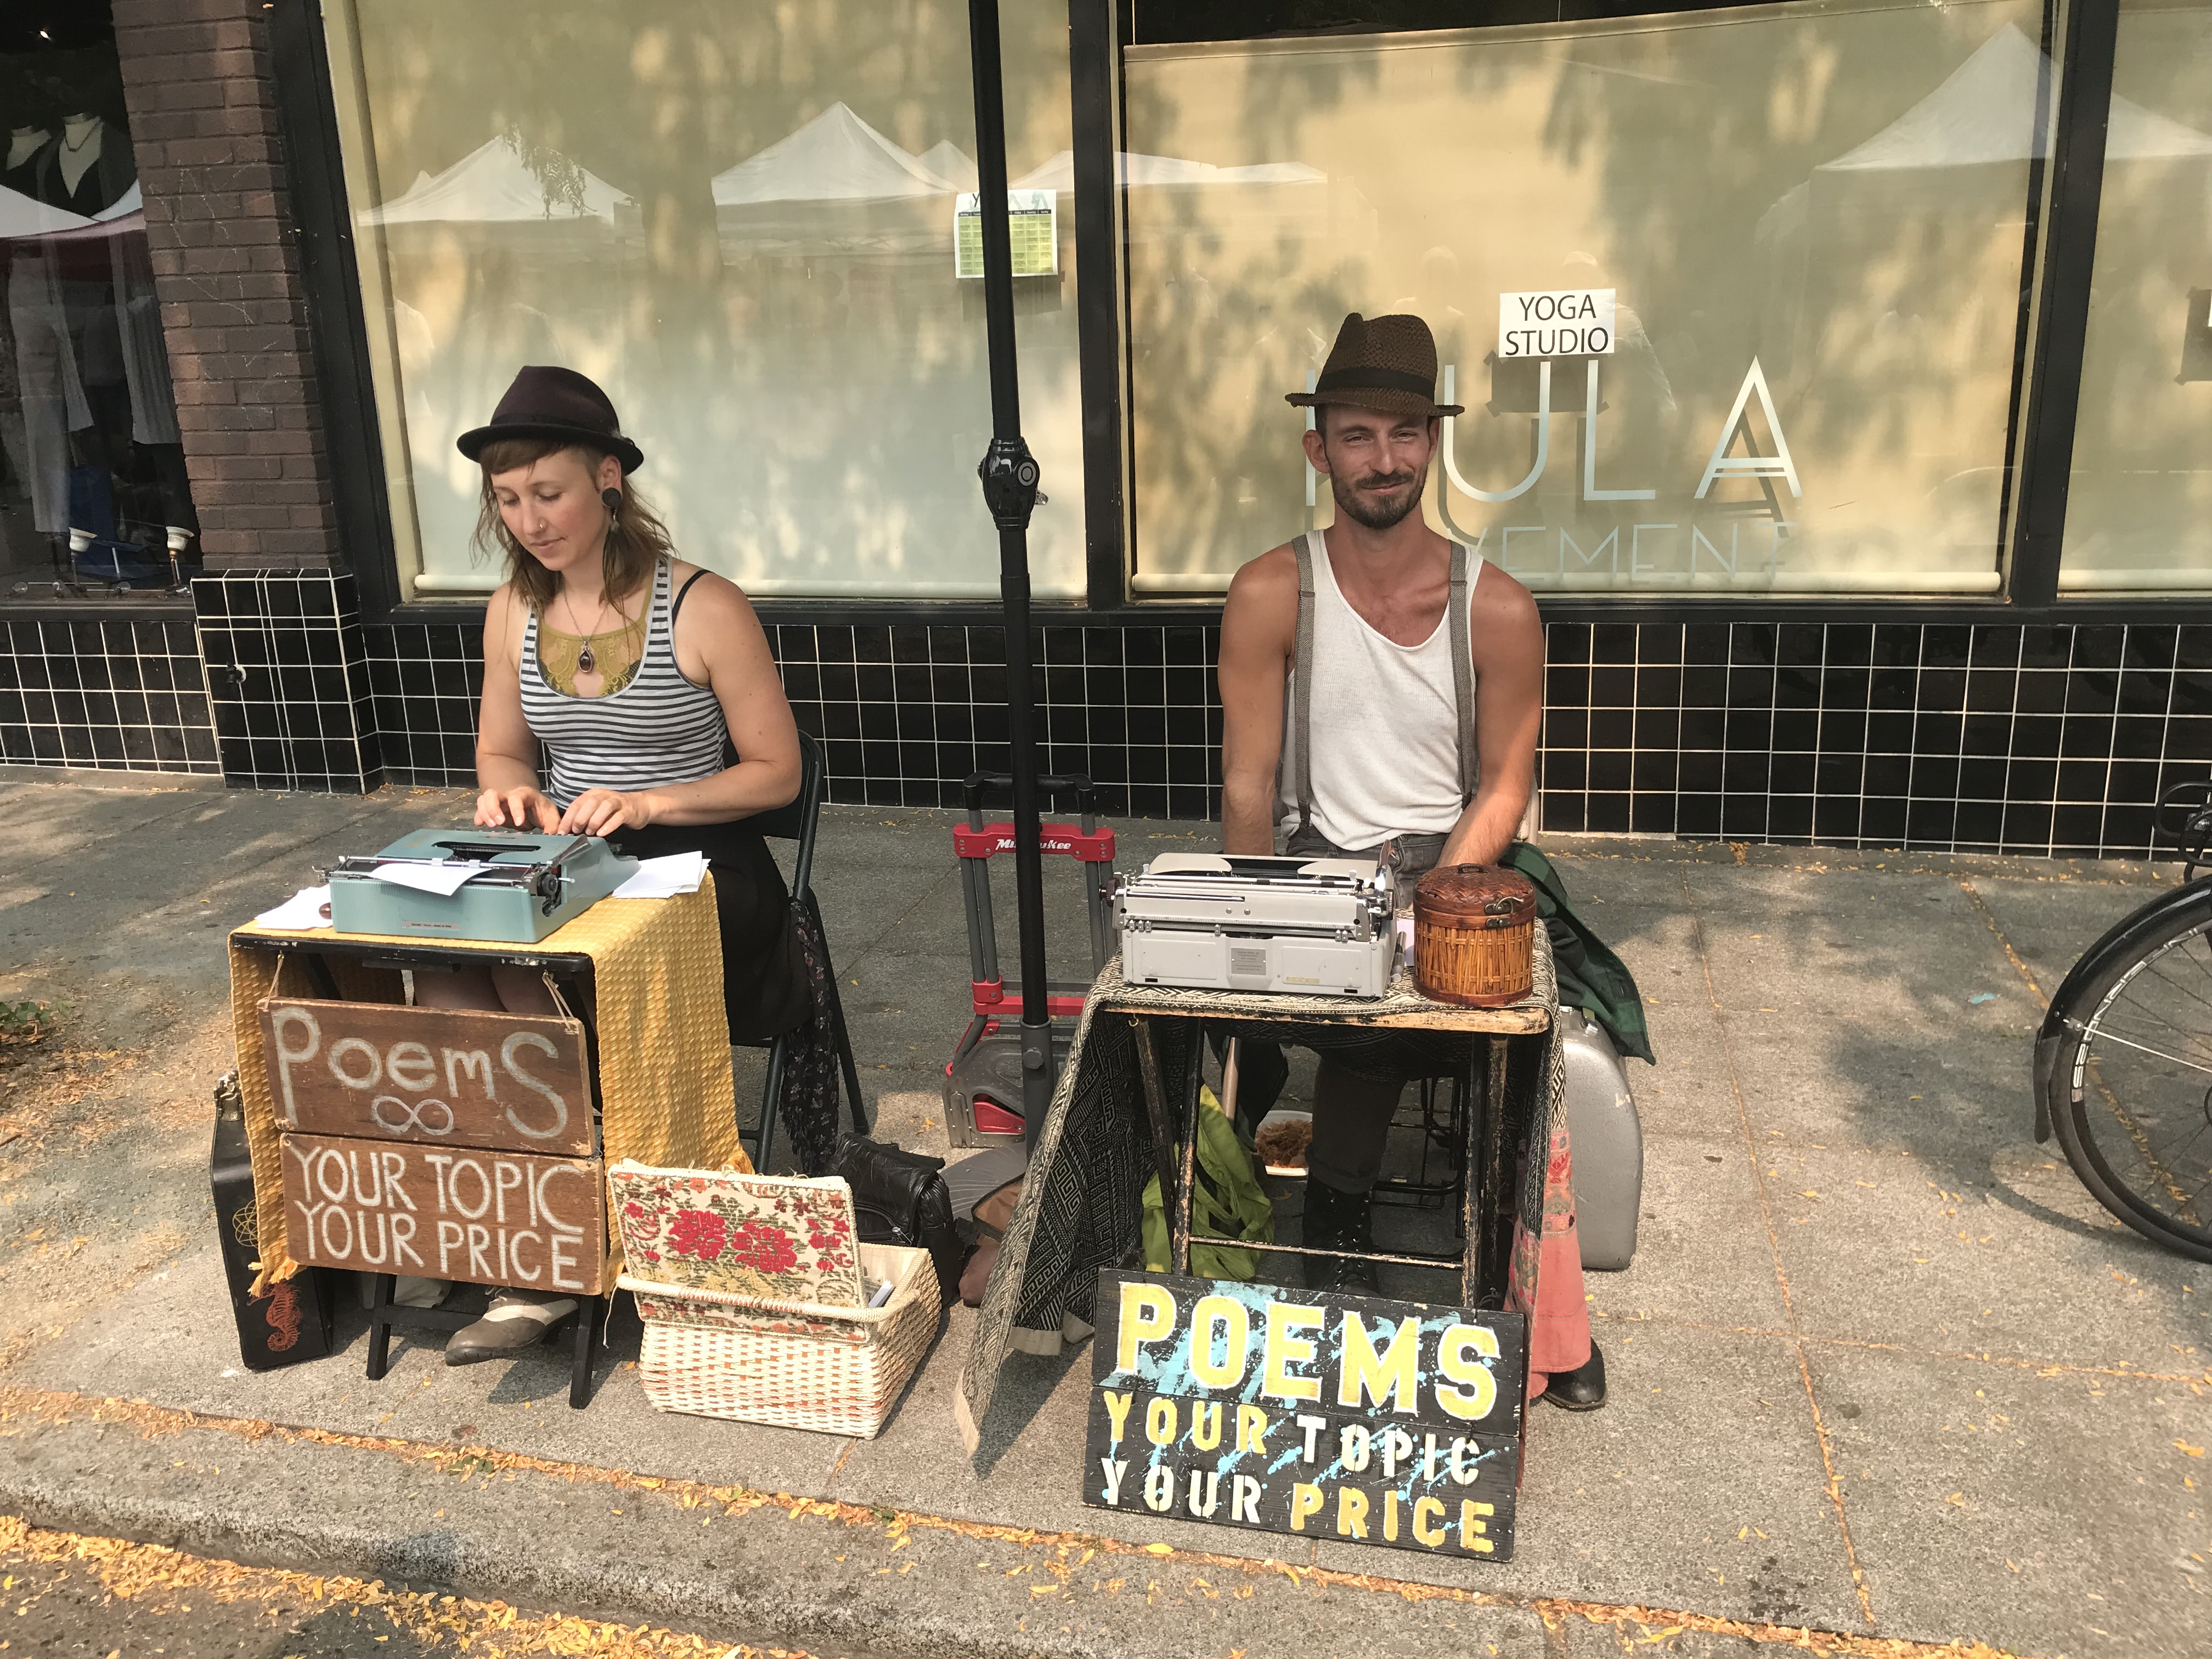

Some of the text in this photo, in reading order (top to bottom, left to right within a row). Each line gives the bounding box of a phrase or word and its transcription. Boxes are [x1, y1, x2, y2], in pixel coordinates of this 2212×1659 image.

[1504, 327, 1609, 356] STUDIO
[1519, 294, 1596, 322] YOGA
[289, 1145, 584, 1235] YOUR TOPIC
[294, 1199, 584, 1289] YOUR PRICE
[1114, 1281, 1502, 1421] POEMS
[1103, 1390, 1481, 1486] YOUR TOPIC
[1101, 1457, 1496, 1554] YOUR PRICE
